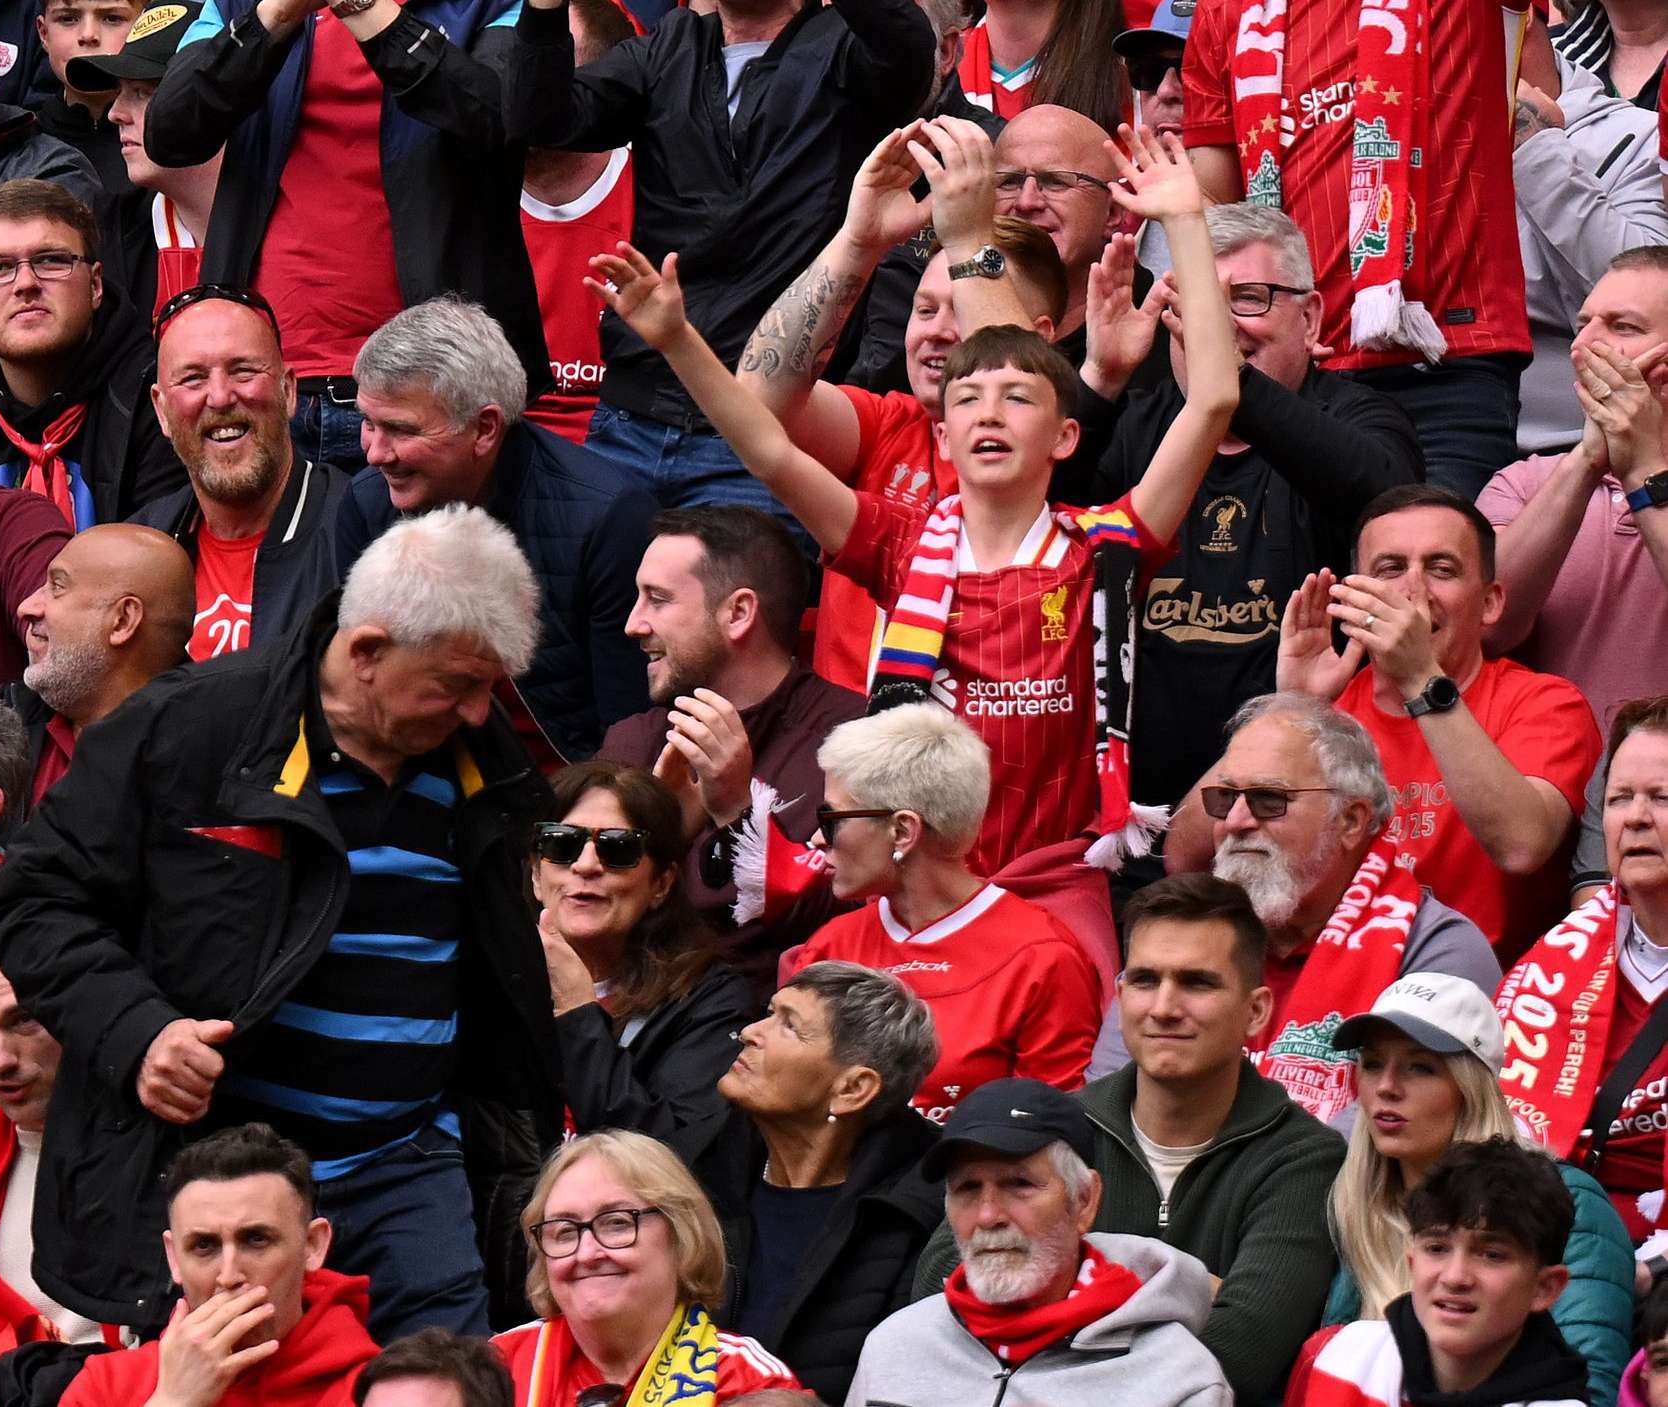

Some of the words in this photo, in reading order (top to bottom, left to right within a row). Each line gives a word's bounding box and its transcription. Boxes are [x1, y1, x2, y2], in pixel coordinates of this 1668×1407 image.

[964, 693, 1074, 717] chartered
[965, 674, 1067, 698] standard
[1315, 851, 1388, 947] ALONE
[1499, 961, 1565, 1092] 2025
[1553, 1028, 1588, 1098] PERCH!
